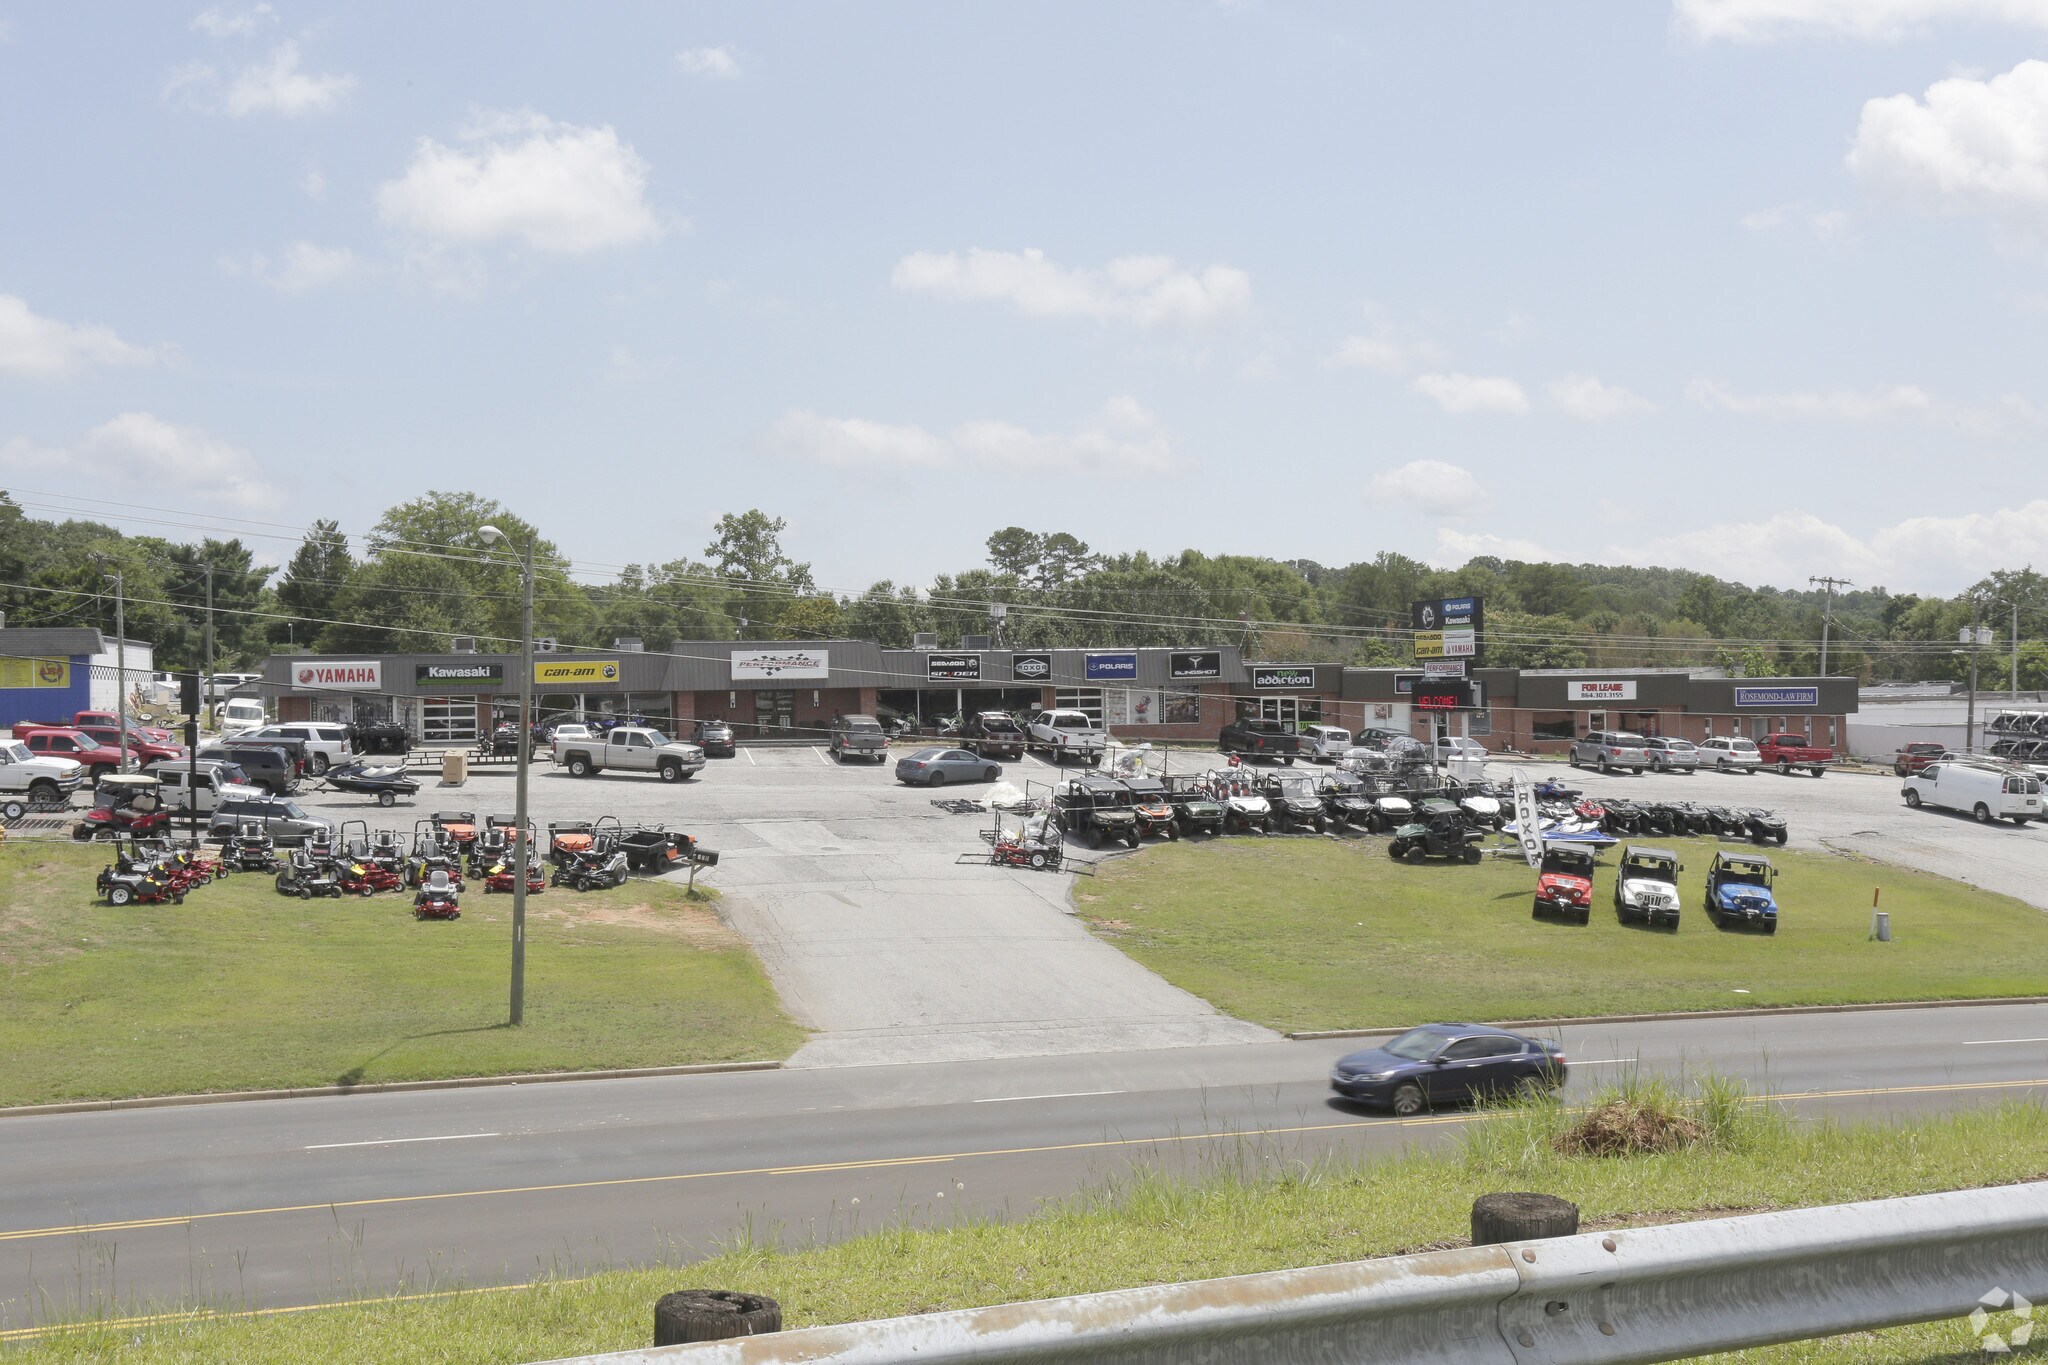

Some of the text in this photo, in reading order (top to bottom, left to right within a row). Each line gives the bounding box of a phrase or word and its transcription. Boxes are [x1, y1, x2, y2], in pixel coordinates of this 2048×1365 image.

[1445, 615, 1470, 624] Kawasaki
[1451, 645, 1473, 653] YAMAHA
[429, 667, 490, 677] Kawasaki
[544, 668, 595, 677] can-am
[1426, 664, 1463, 672] PERFORMANCE
[316, 668, 376, 683] YAMAHA
[1276, 670, 1298, 678] new
[1257, 675, 1310, 684] addiction
[1796, 692, 1814, 700] FIRM
